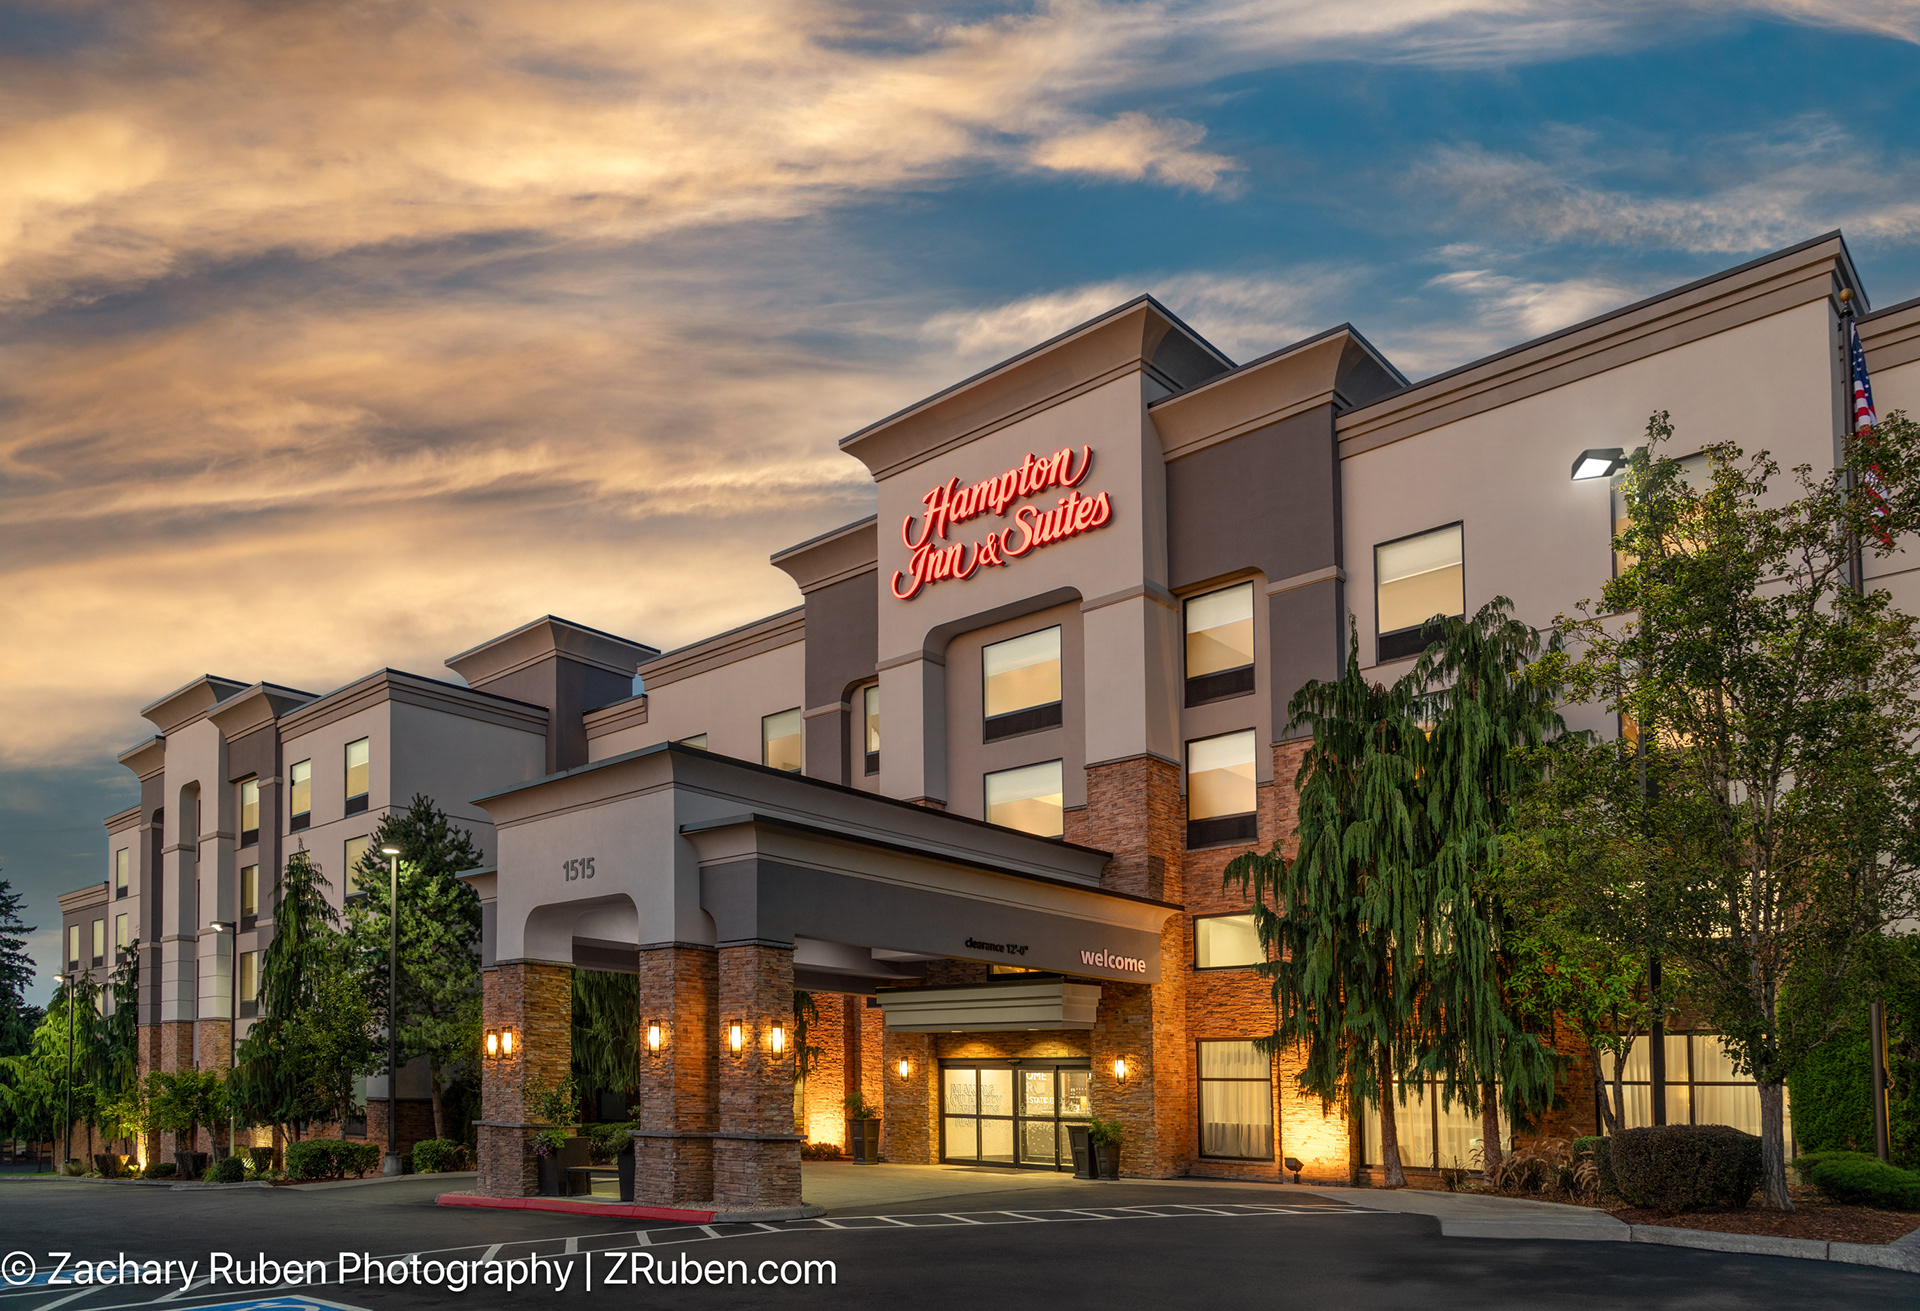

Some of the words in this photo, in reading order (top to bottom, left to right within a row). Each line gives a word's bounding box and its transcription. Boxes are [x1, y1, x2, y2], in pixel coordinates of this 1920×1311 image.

[902, 444, 1094, 551] Hampton
[891, 541, 980, 600] Inn
[978, 531, 1006, 567] &
[1000, 490, 1112, 558] Suites
[562, 857, 595, 881] 1515
[965, 936, 1005, 953] clearance
[1080, 949, 1147, 973] welcome
